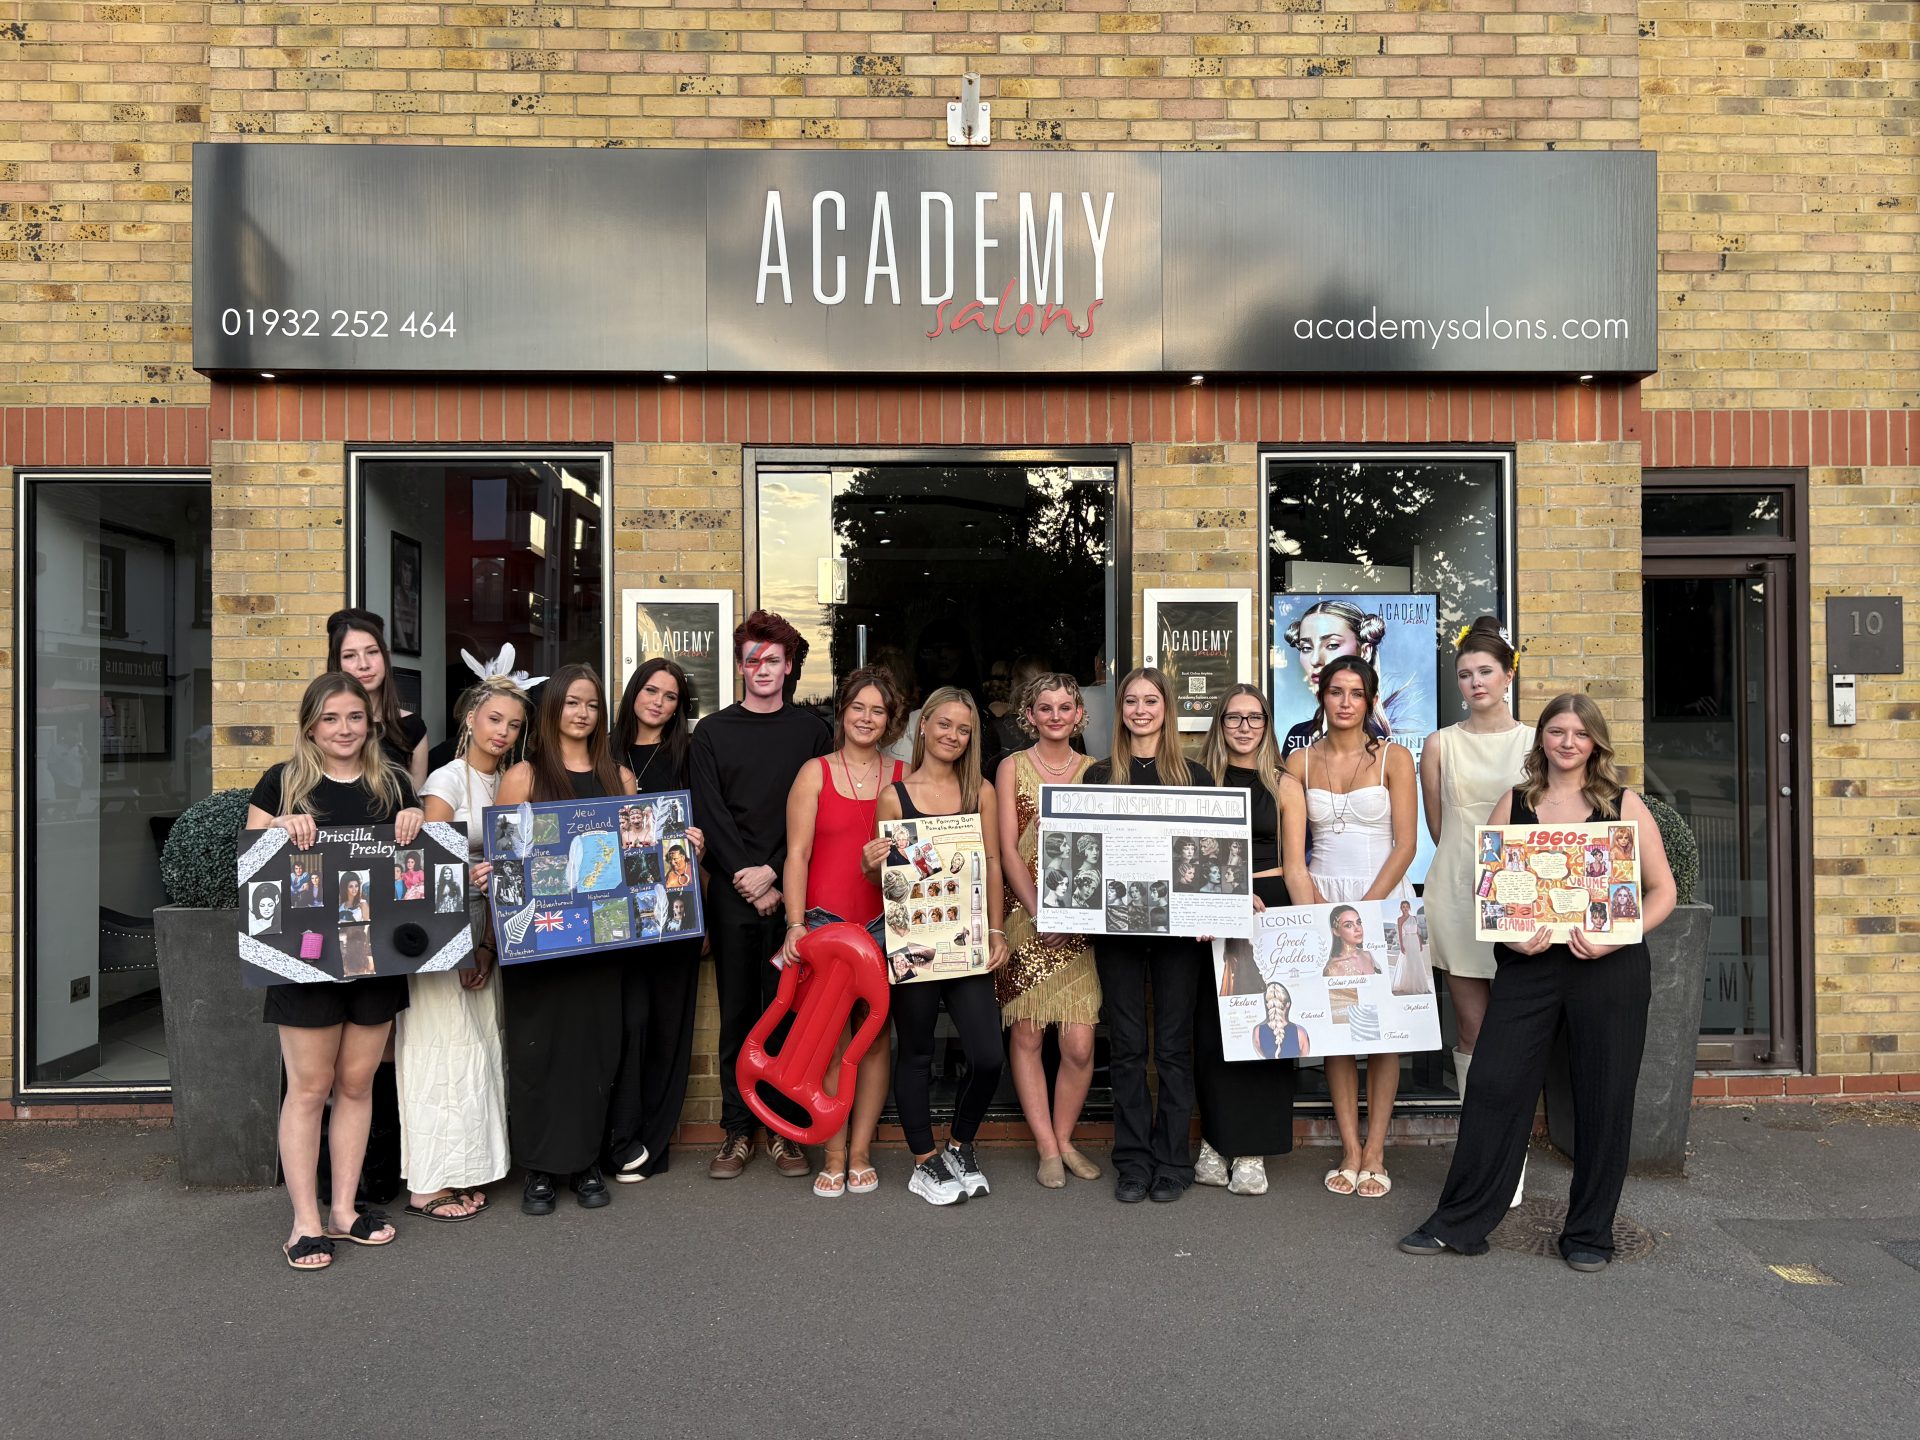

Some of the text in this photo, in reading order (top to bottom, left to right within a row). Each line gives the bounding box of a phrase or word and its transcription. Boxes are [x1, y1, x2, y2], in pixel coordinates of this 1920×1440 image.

[755, 190, 1115, 305] ACADEMY
[925, 276, 1105, 338] salons
[221, 308, 457, 339] 01932 252 464
[1293, 305, 1628, 350] academysalons.com
[1379, 603, 1431, 620] ACADEMY
[1850, 611, 1883, 636] 10
[642, 631, 711, 652] ACADEMY
[1162, 630, 1230, 651] ACADEMY
[572, 809, 596, 819] New
[1112, 794, 1187, 815] INSPIRED
[1196, 798, 1242, 817] HAIR
[317, 827, 372, 844] Priscilla
[351, 840, 396, 857] Presley
[1569, 876, 1608, 889] VOLUME
[1260, 913, 1312, 928] ICONIC
[1497, 917, 1536, 932] GLAMOUR
[1276, 932, 1307, 947] Greek
[1264, 947, 1314, 980] Goddess
[1229, 996, 1257, 1007] Texture
